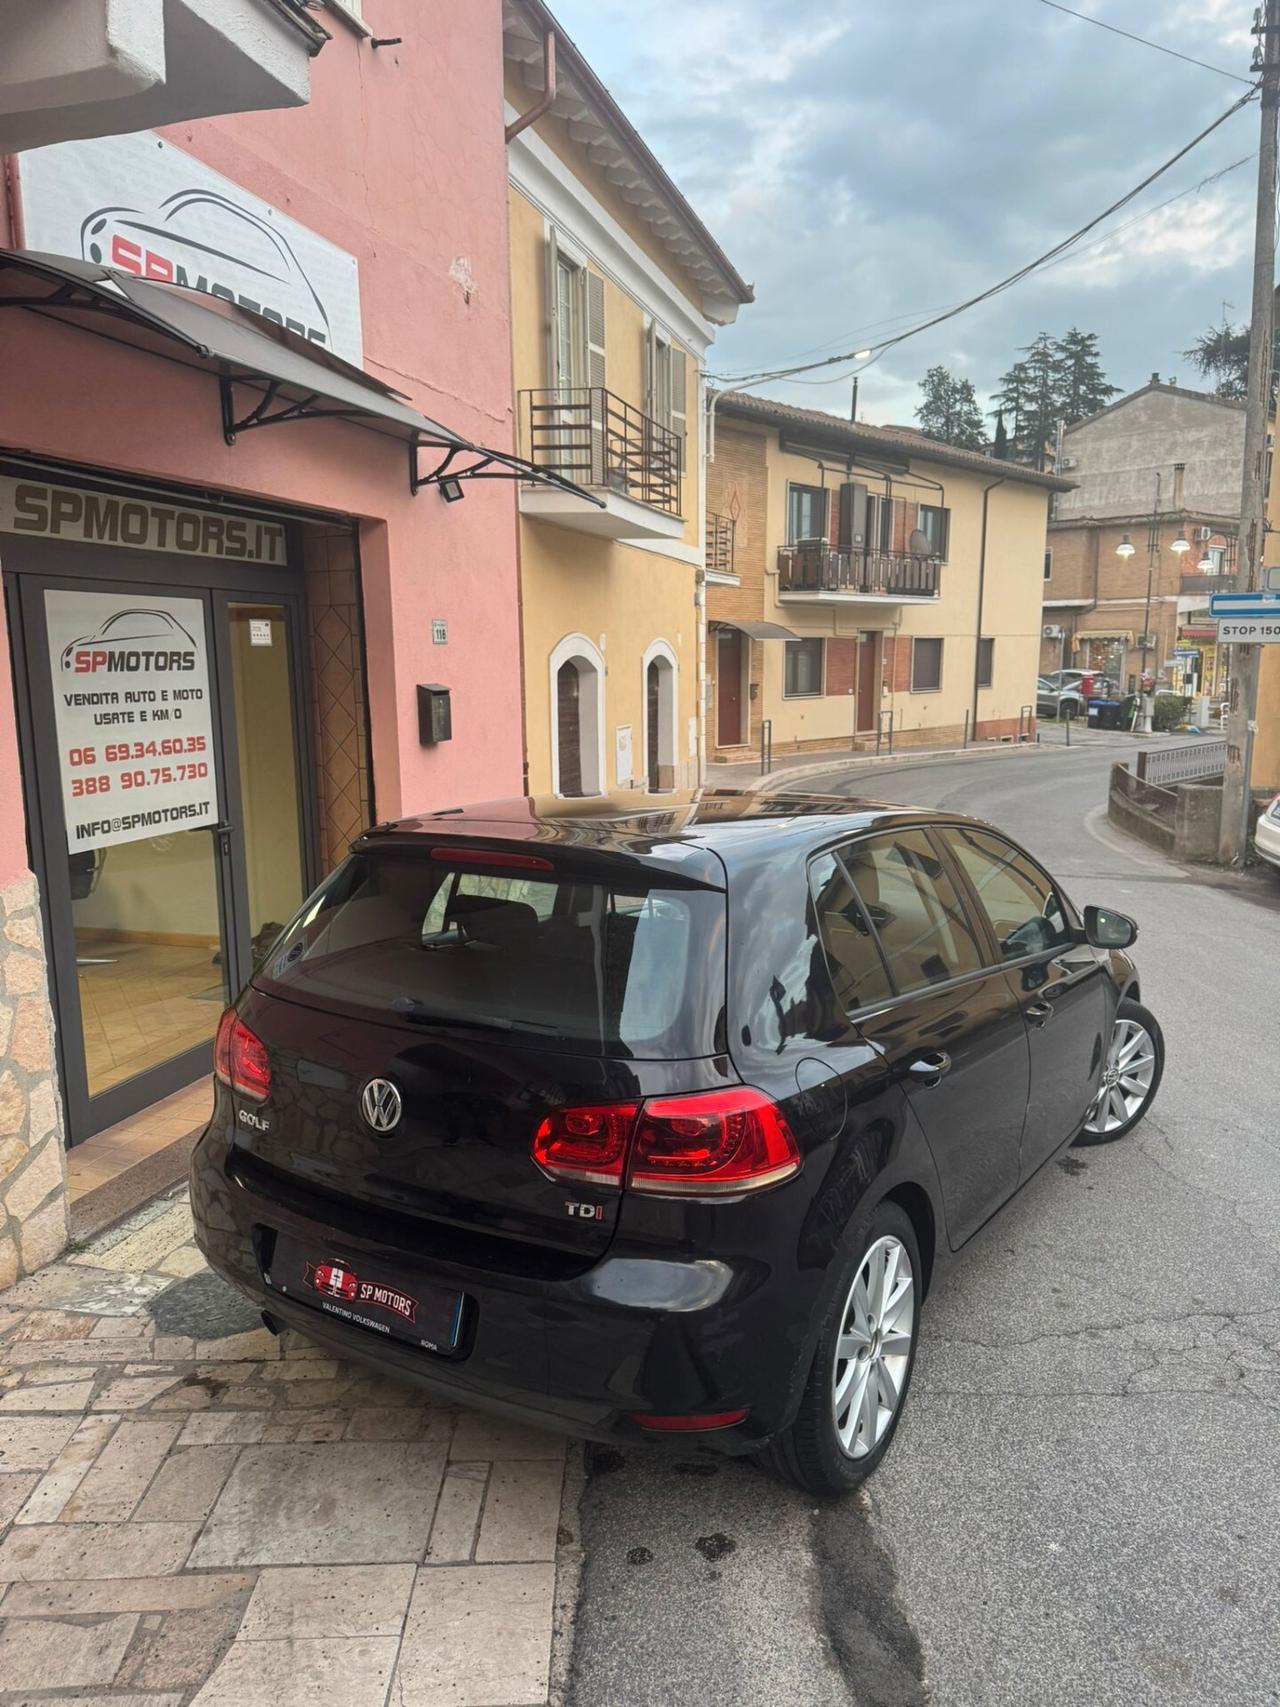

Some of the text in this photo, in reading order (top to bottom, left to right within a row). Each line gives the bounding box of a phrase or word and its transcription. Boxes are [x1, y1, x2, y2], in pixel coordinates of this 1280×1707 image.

[13, 484, 282, 561] SPMOTORS.IT
[1223, 626, 1256, 635] STOP
[74, 651, 195, 673] SPMOTORS
[64, 688, 203, 706] VENDITA AUTO E MOTO
[94, 711, 135, 725] USATE
[140, 710, 147, 722] E
[69, 736, 206, 767] 06 69.34.60.35
[71, 762, 208, 797] 388 90.75.730
[76, 801, 210, 840] INFO@SPMOTORS.IT
[238, 1109, 270, 1131] GOLF
[564, 1201, 603, 1220] TDI
[360, 1283, 412, 1316] SP MOTORS
[322, 1302, 390, 1333] VALENTINO VOLKSWAGEN
[420, 1339, 437, 1351] ROMA
